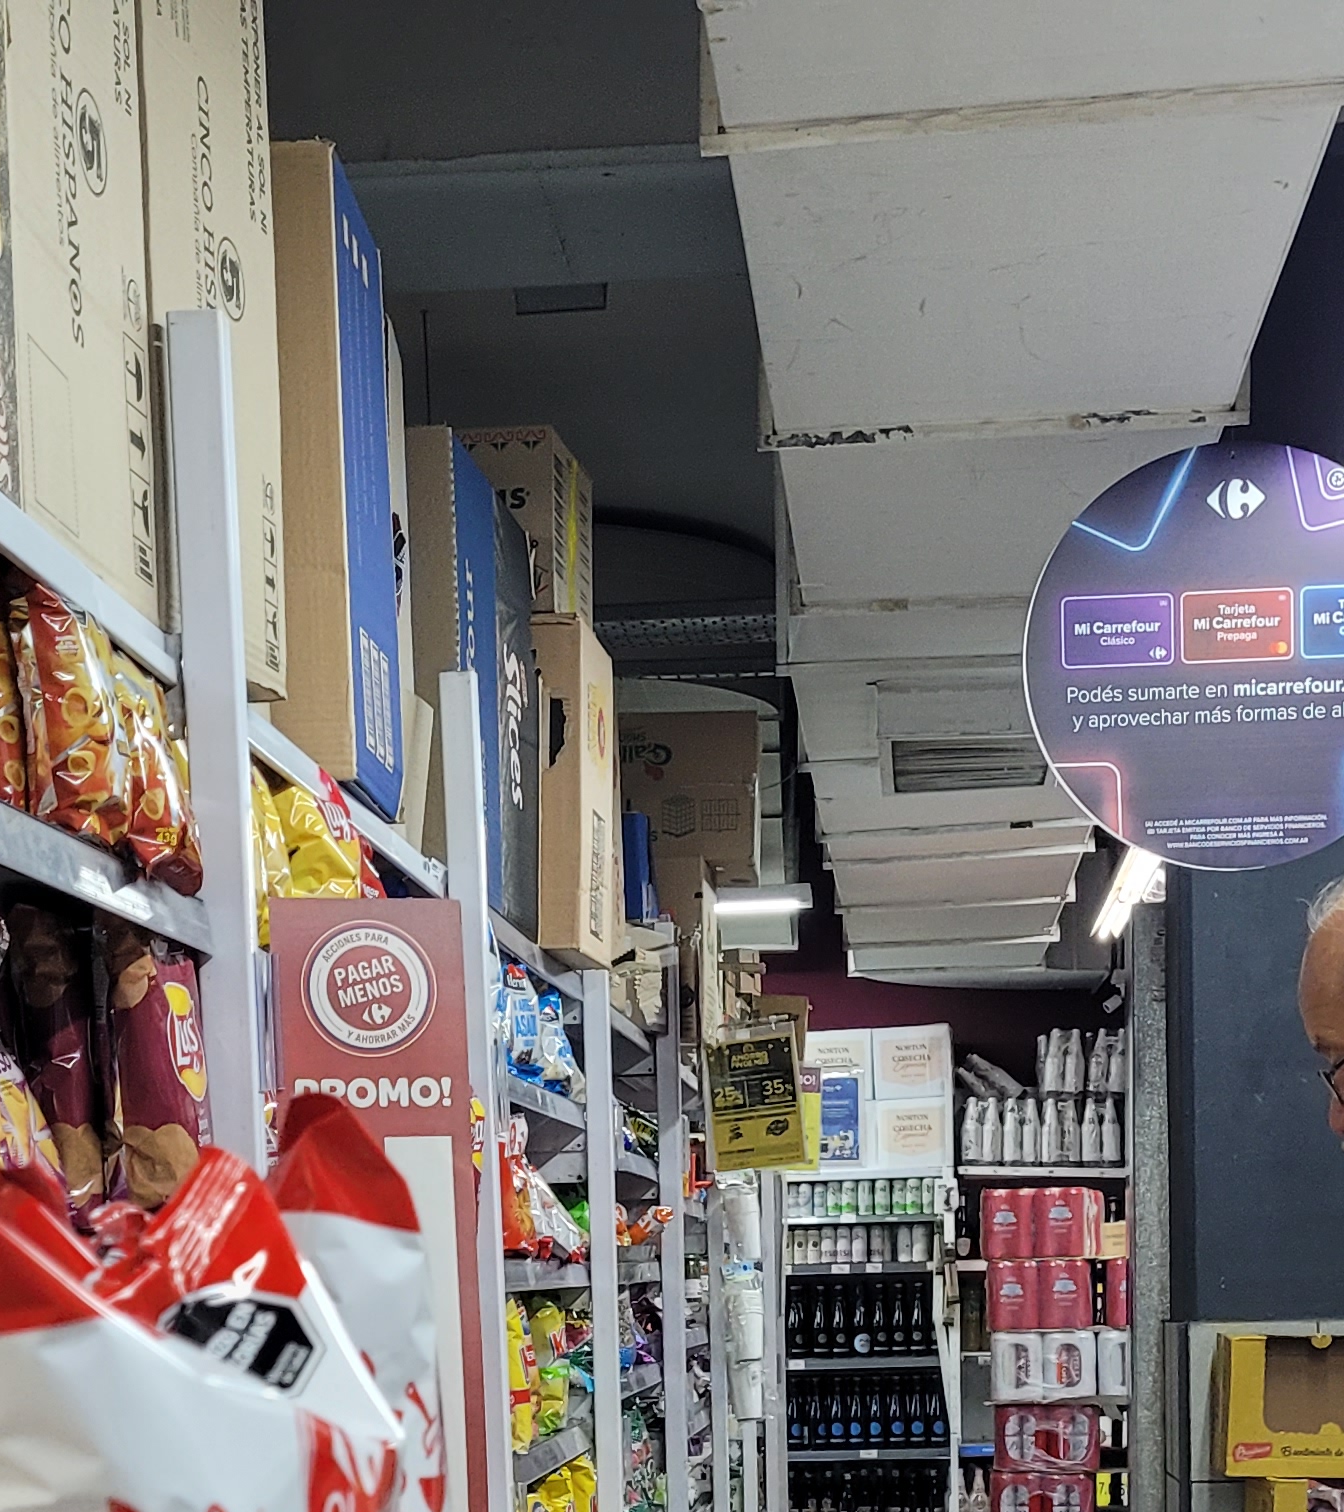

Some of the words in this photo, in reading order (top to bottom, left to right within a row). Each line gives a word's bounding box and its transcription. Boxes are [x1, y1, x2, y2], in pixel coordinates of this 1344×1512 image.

[196, 75, 213, 212] CINCO
[240, 37, 256, 223] TEMPERATURAS
[256, 154, 266, 199] SOL
[59, 65, 84, 349] HISPANOS
[259, 210, 267, 236] NI
[1193, 618, 1210, 631] Mi
[1212, 615, 1281, 630] Carrefour
[1218, 603, 1256, 617] Tarjeta
[1313, 612, 1330, 625] Mi
[1074, 622, 1091, 636] Mi
[1092, 620, 1162, 635] Carrefour
[1100, 634, 1136, 647] Clásico
[1216, 630, 1258, 642] Prepaga
[1066, 686, 1123, 704] Podés
[1127, 684, 1201, 701] sumarte
[1205, 684, 1229, 699] en
[503, 643, 523, 811] Slices
[1072, 714, 1084, 732] y
[1088, 708, 1190, 730] aprovechar
[1195, 706, 1232, 725] más
[1236, 702, 1298, 723] formas
[1302, 701, 1327, 720] de
[321, 932, 362, 963] ACCIONES
[364, 932, 389, 945] PARA
[333, 954, 397, 987] PAGAR
[336, 974, 404, 1008] MENOS
[347, 1030, 353, 1040] Y
[355, 1029, 399, 1044] AHORRAR
